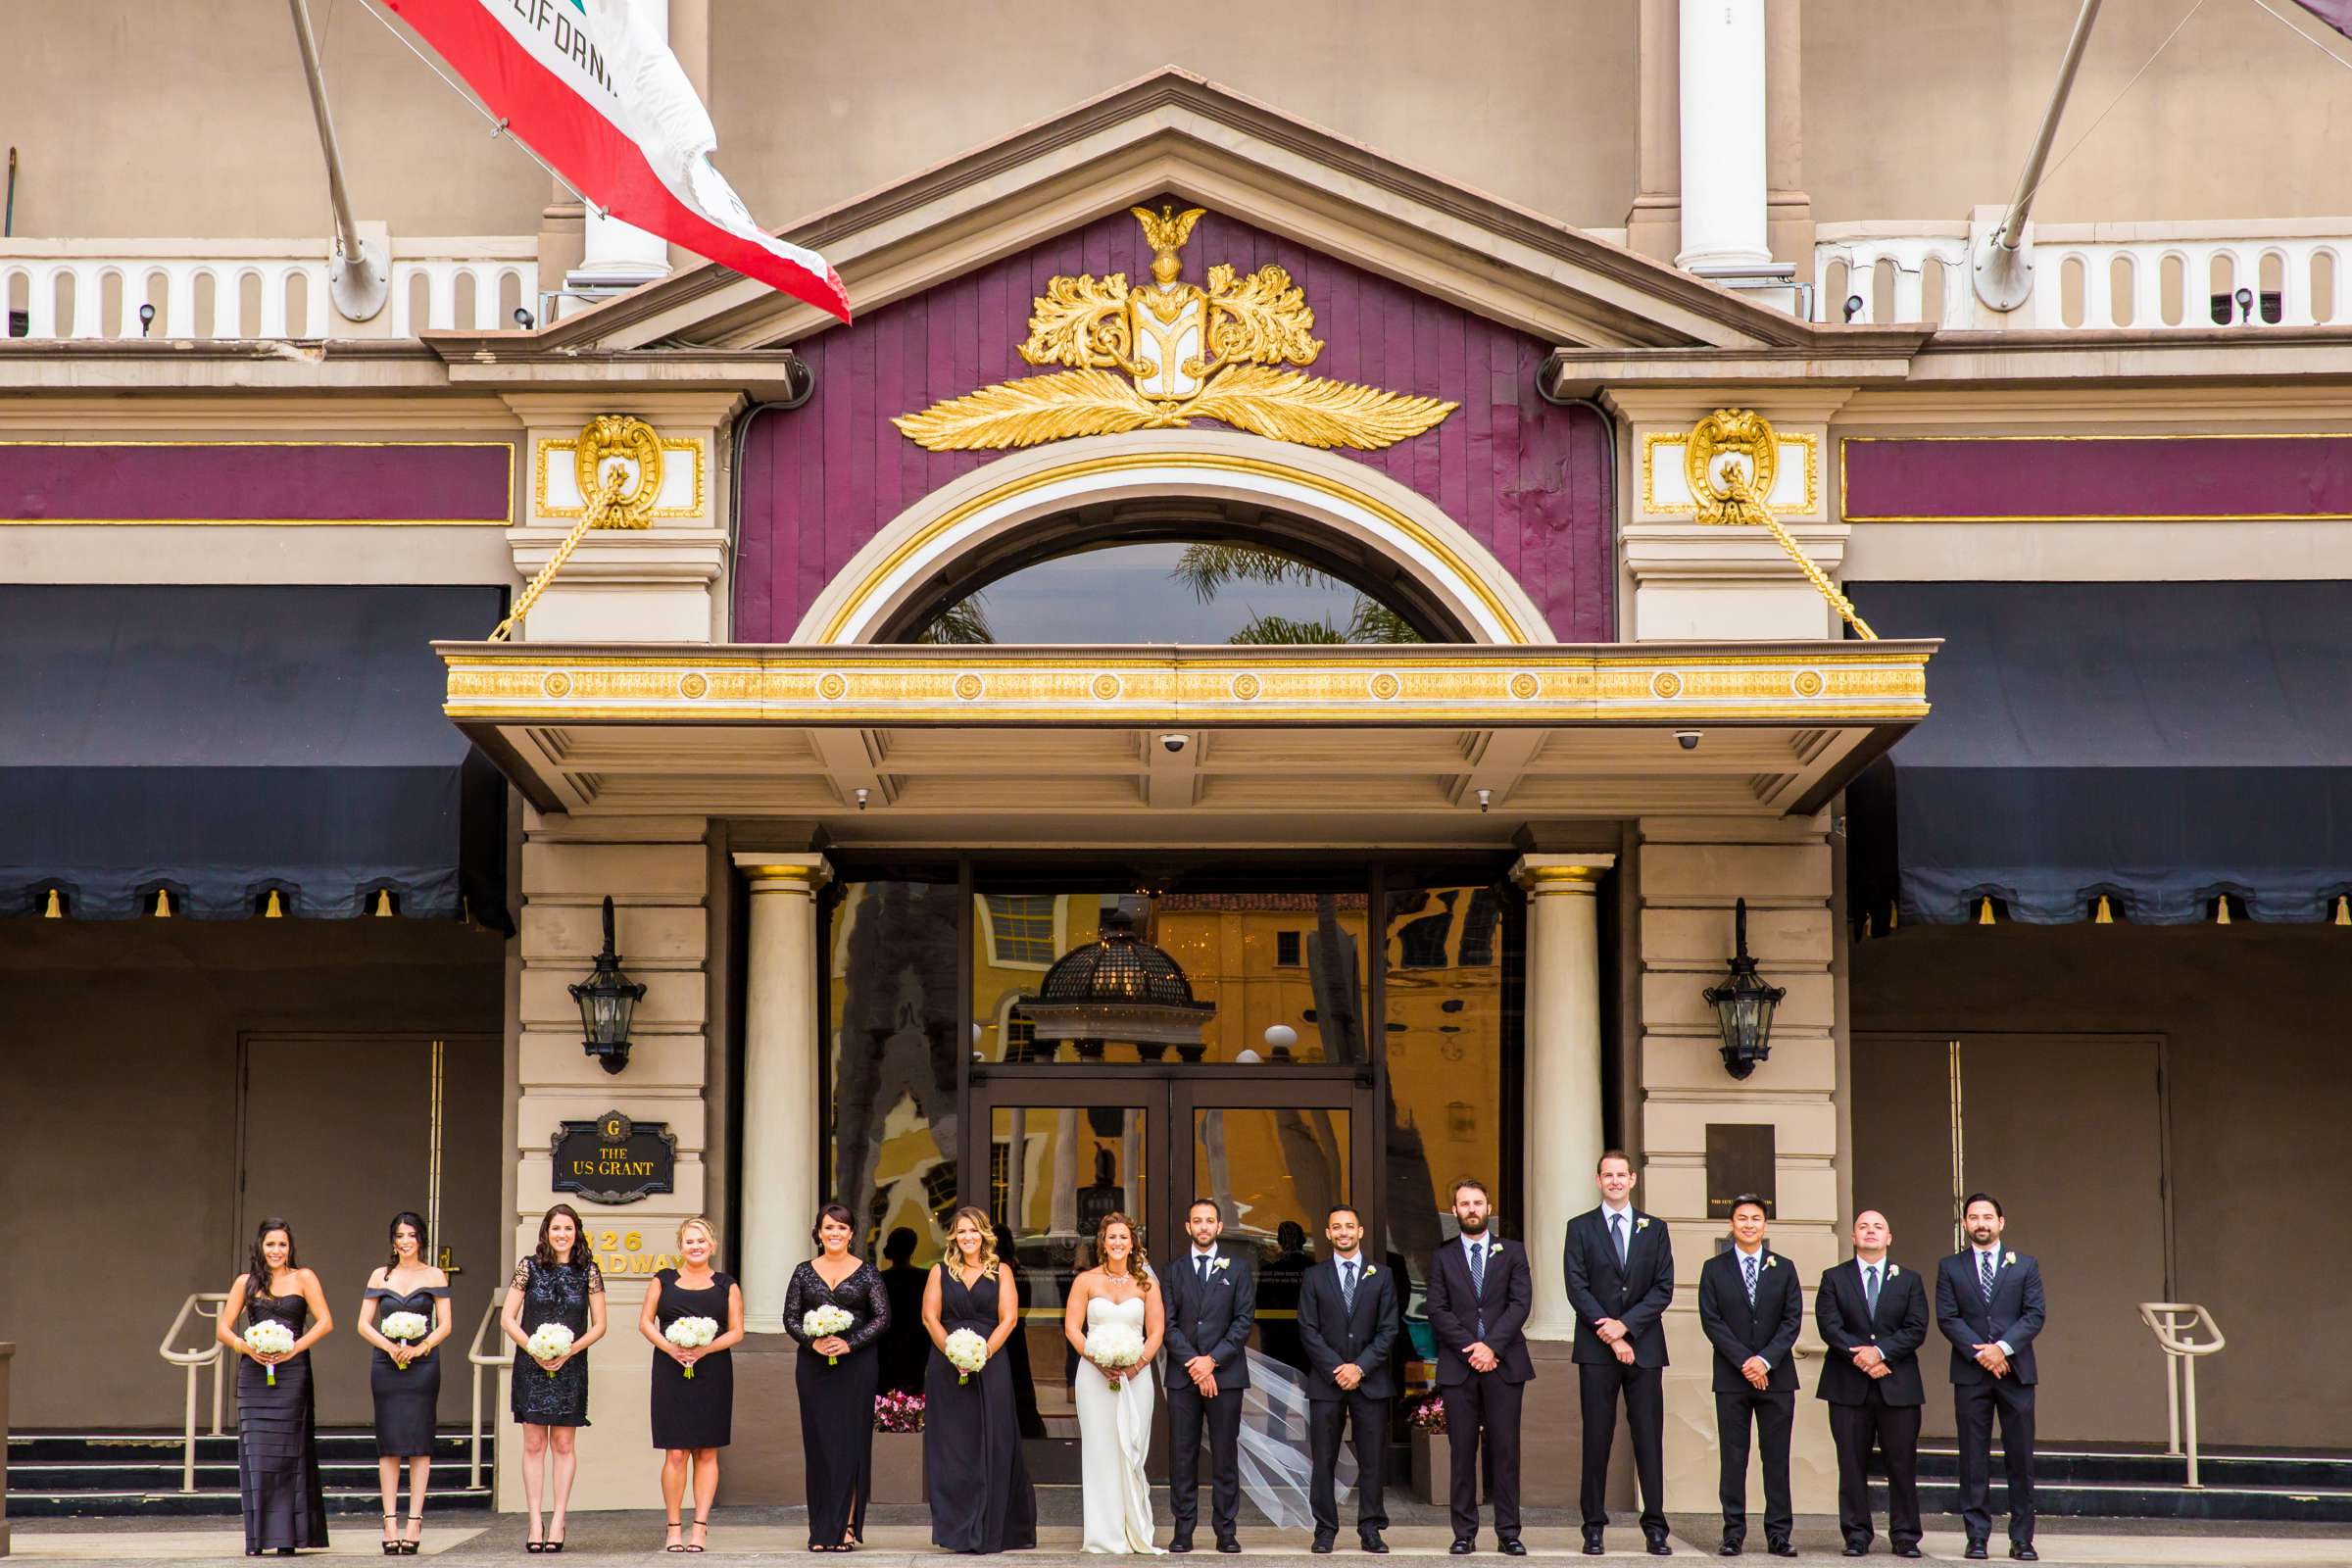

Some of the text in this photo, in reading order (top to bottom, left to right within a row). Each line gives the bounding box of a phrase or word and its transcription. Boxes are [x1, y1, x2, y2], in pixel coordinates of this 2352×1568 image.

[608, 1120, 620, 1136] G
[600, 1148, 628, 1159] THE
[573, 1160, 654, 1176] US GRANT
